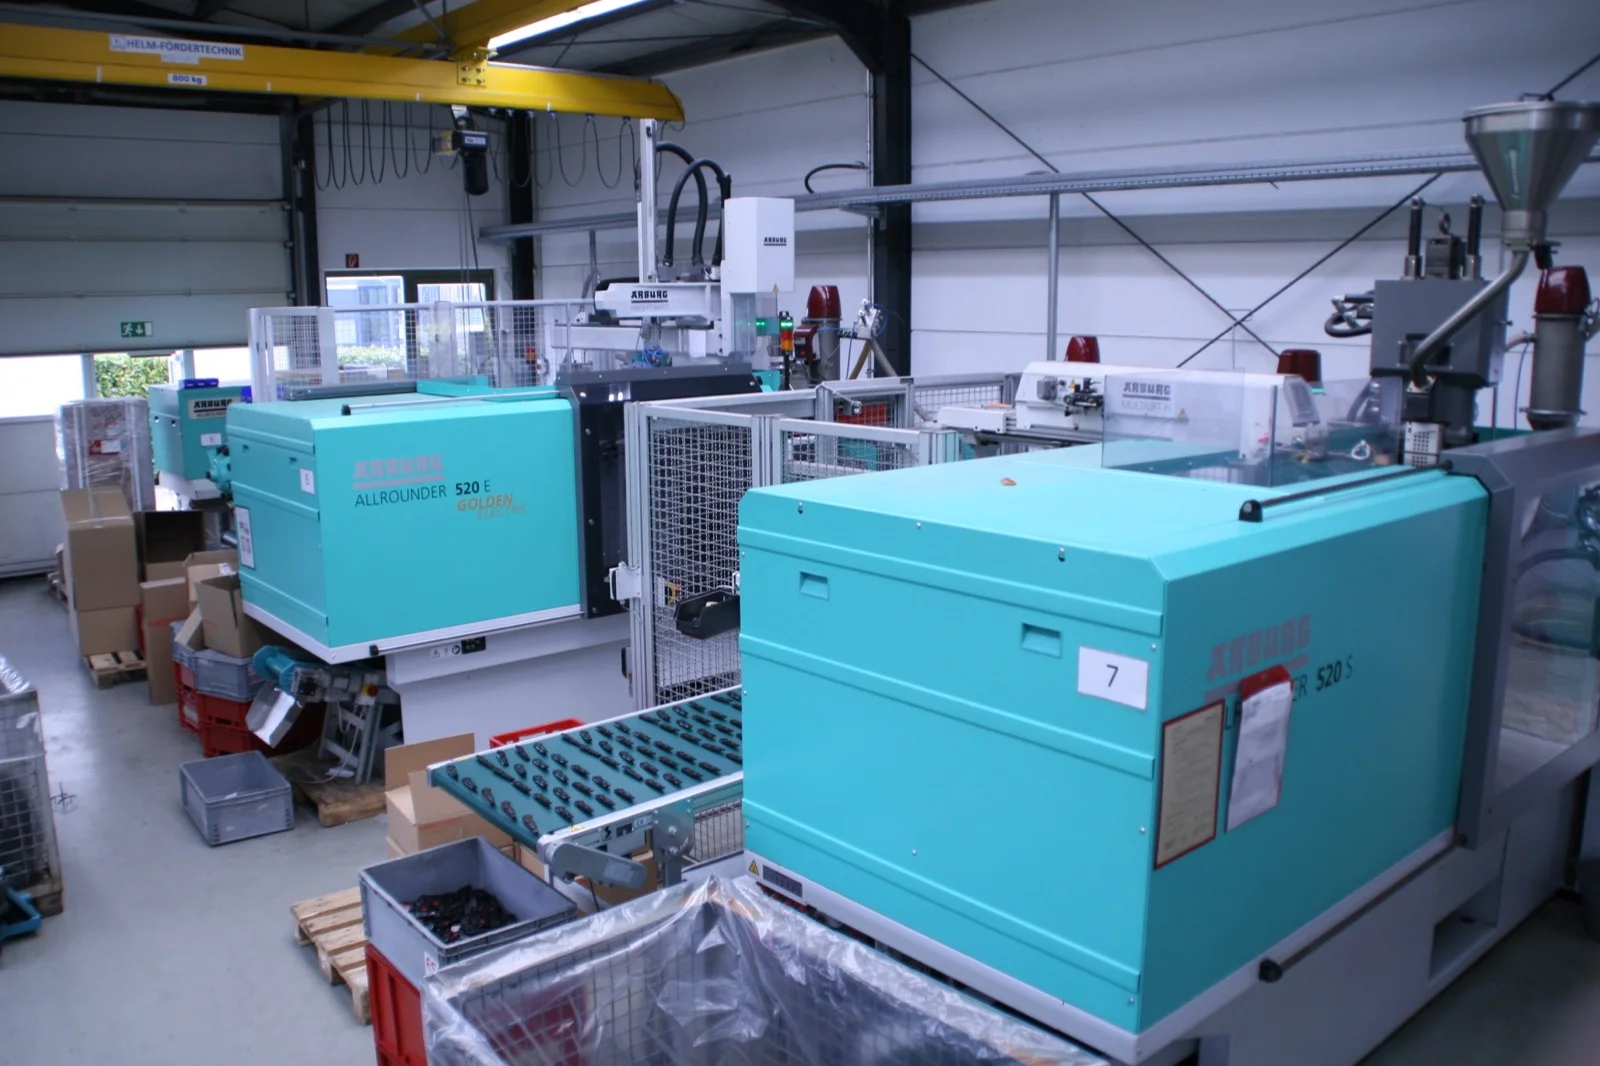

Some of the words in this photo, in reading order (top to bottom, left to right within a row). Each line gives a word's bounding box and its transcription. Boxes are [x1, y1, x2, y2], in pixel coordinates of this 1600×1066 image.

[126, 38, 242, 56] HELM-FÖRDERTECHNIK
[172, 74, 189, 82] 800
[191, 76, 202, 85] kg
[631, 290, 668, 299] ARBURG
[1123, 382, 1171, 395] ARBURG
[353, 454, 443, 480] ARBURG
[354, 484, 447, 507] ALLROUNDER
[455, 481, 480, 495] 520
[483, 479, 491, 493] E
[457, 494, 513, 511] GOLDEN
[1206, 615, 1310, 682] ARBURG
[1106, 664, 1119, 688] 7
[1316, 660, 1342, 692] 520
[1345, 654, 1353, 680] S
